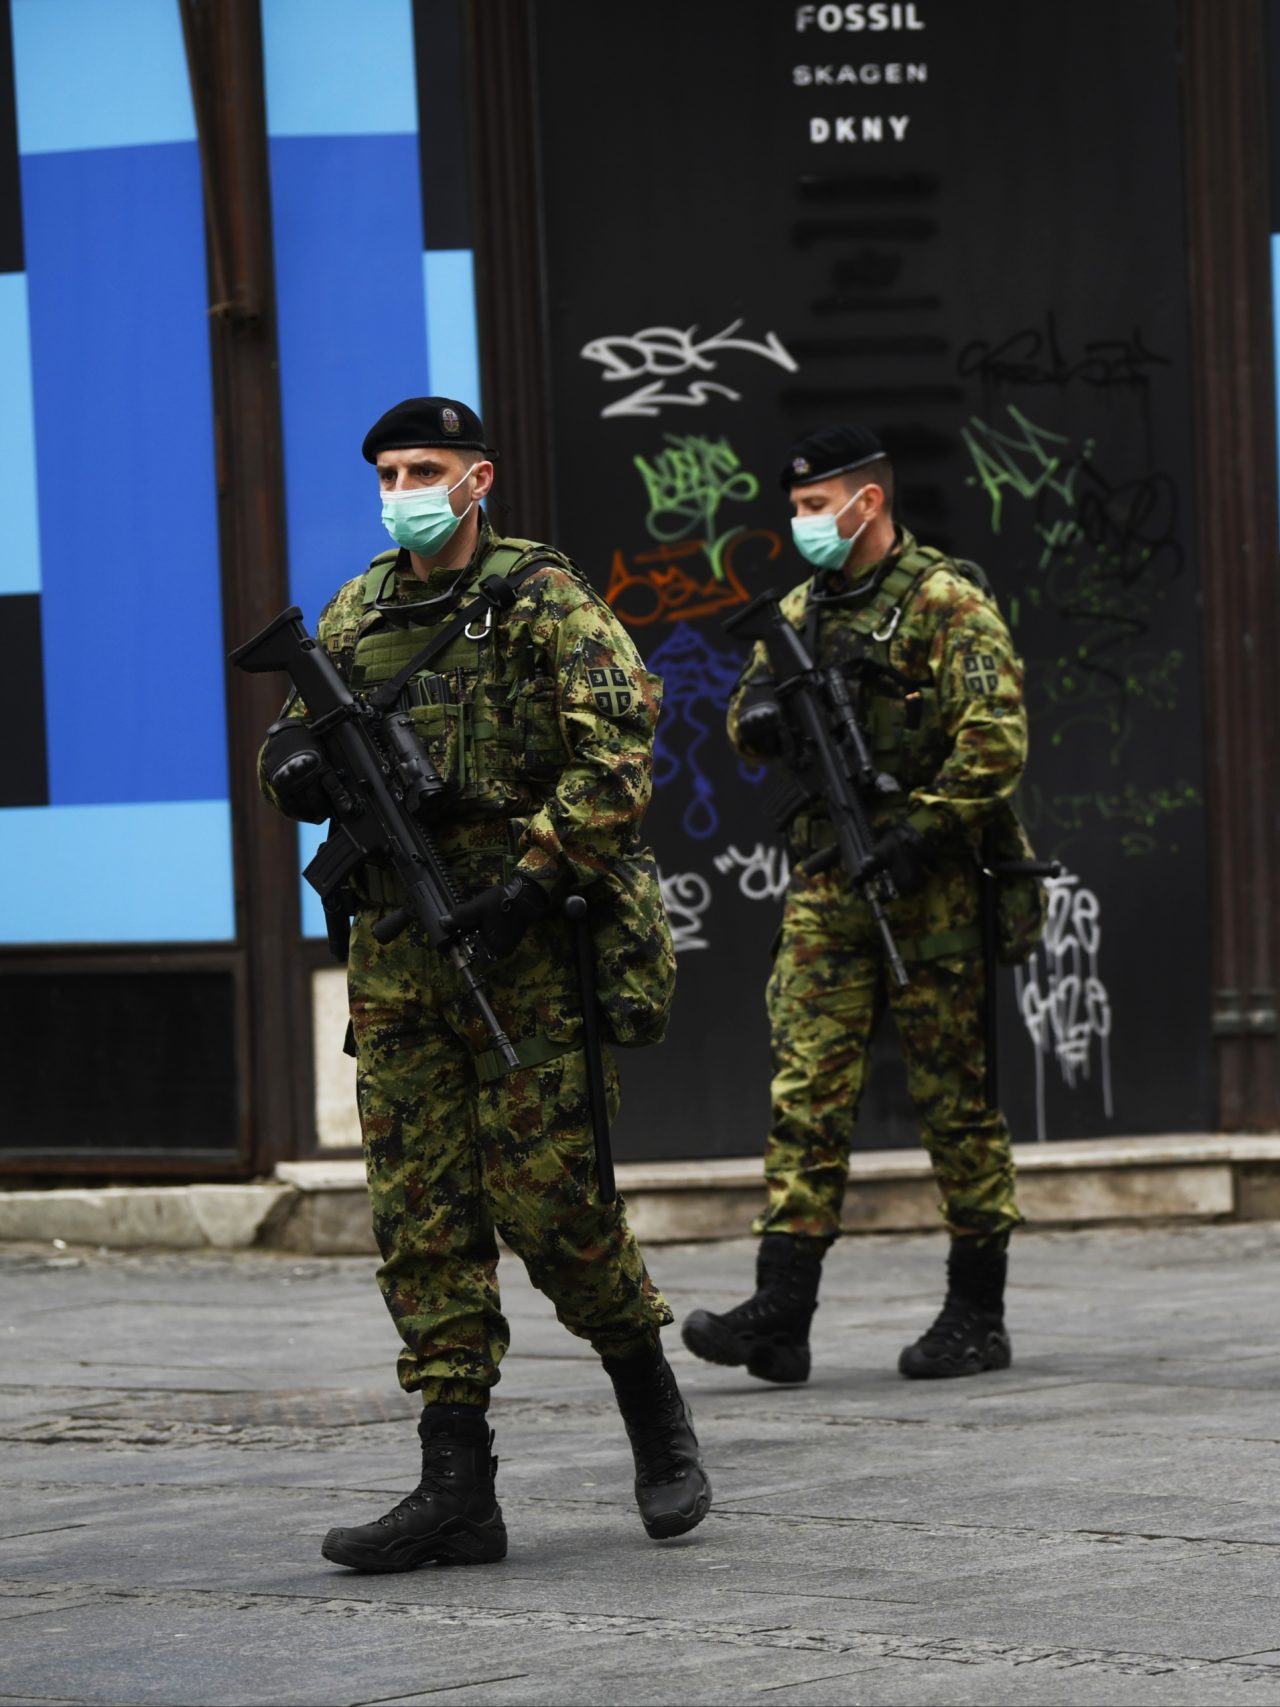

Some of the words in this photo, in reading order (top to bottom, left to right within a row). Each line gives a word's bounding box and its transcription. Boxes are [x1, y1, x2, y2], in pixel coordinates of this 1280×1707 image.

[796, 2, 925, 32] FOSSIL
[792, 62, 927, 86] SKAGEN
[809, 115, 909, 143] DKNY
